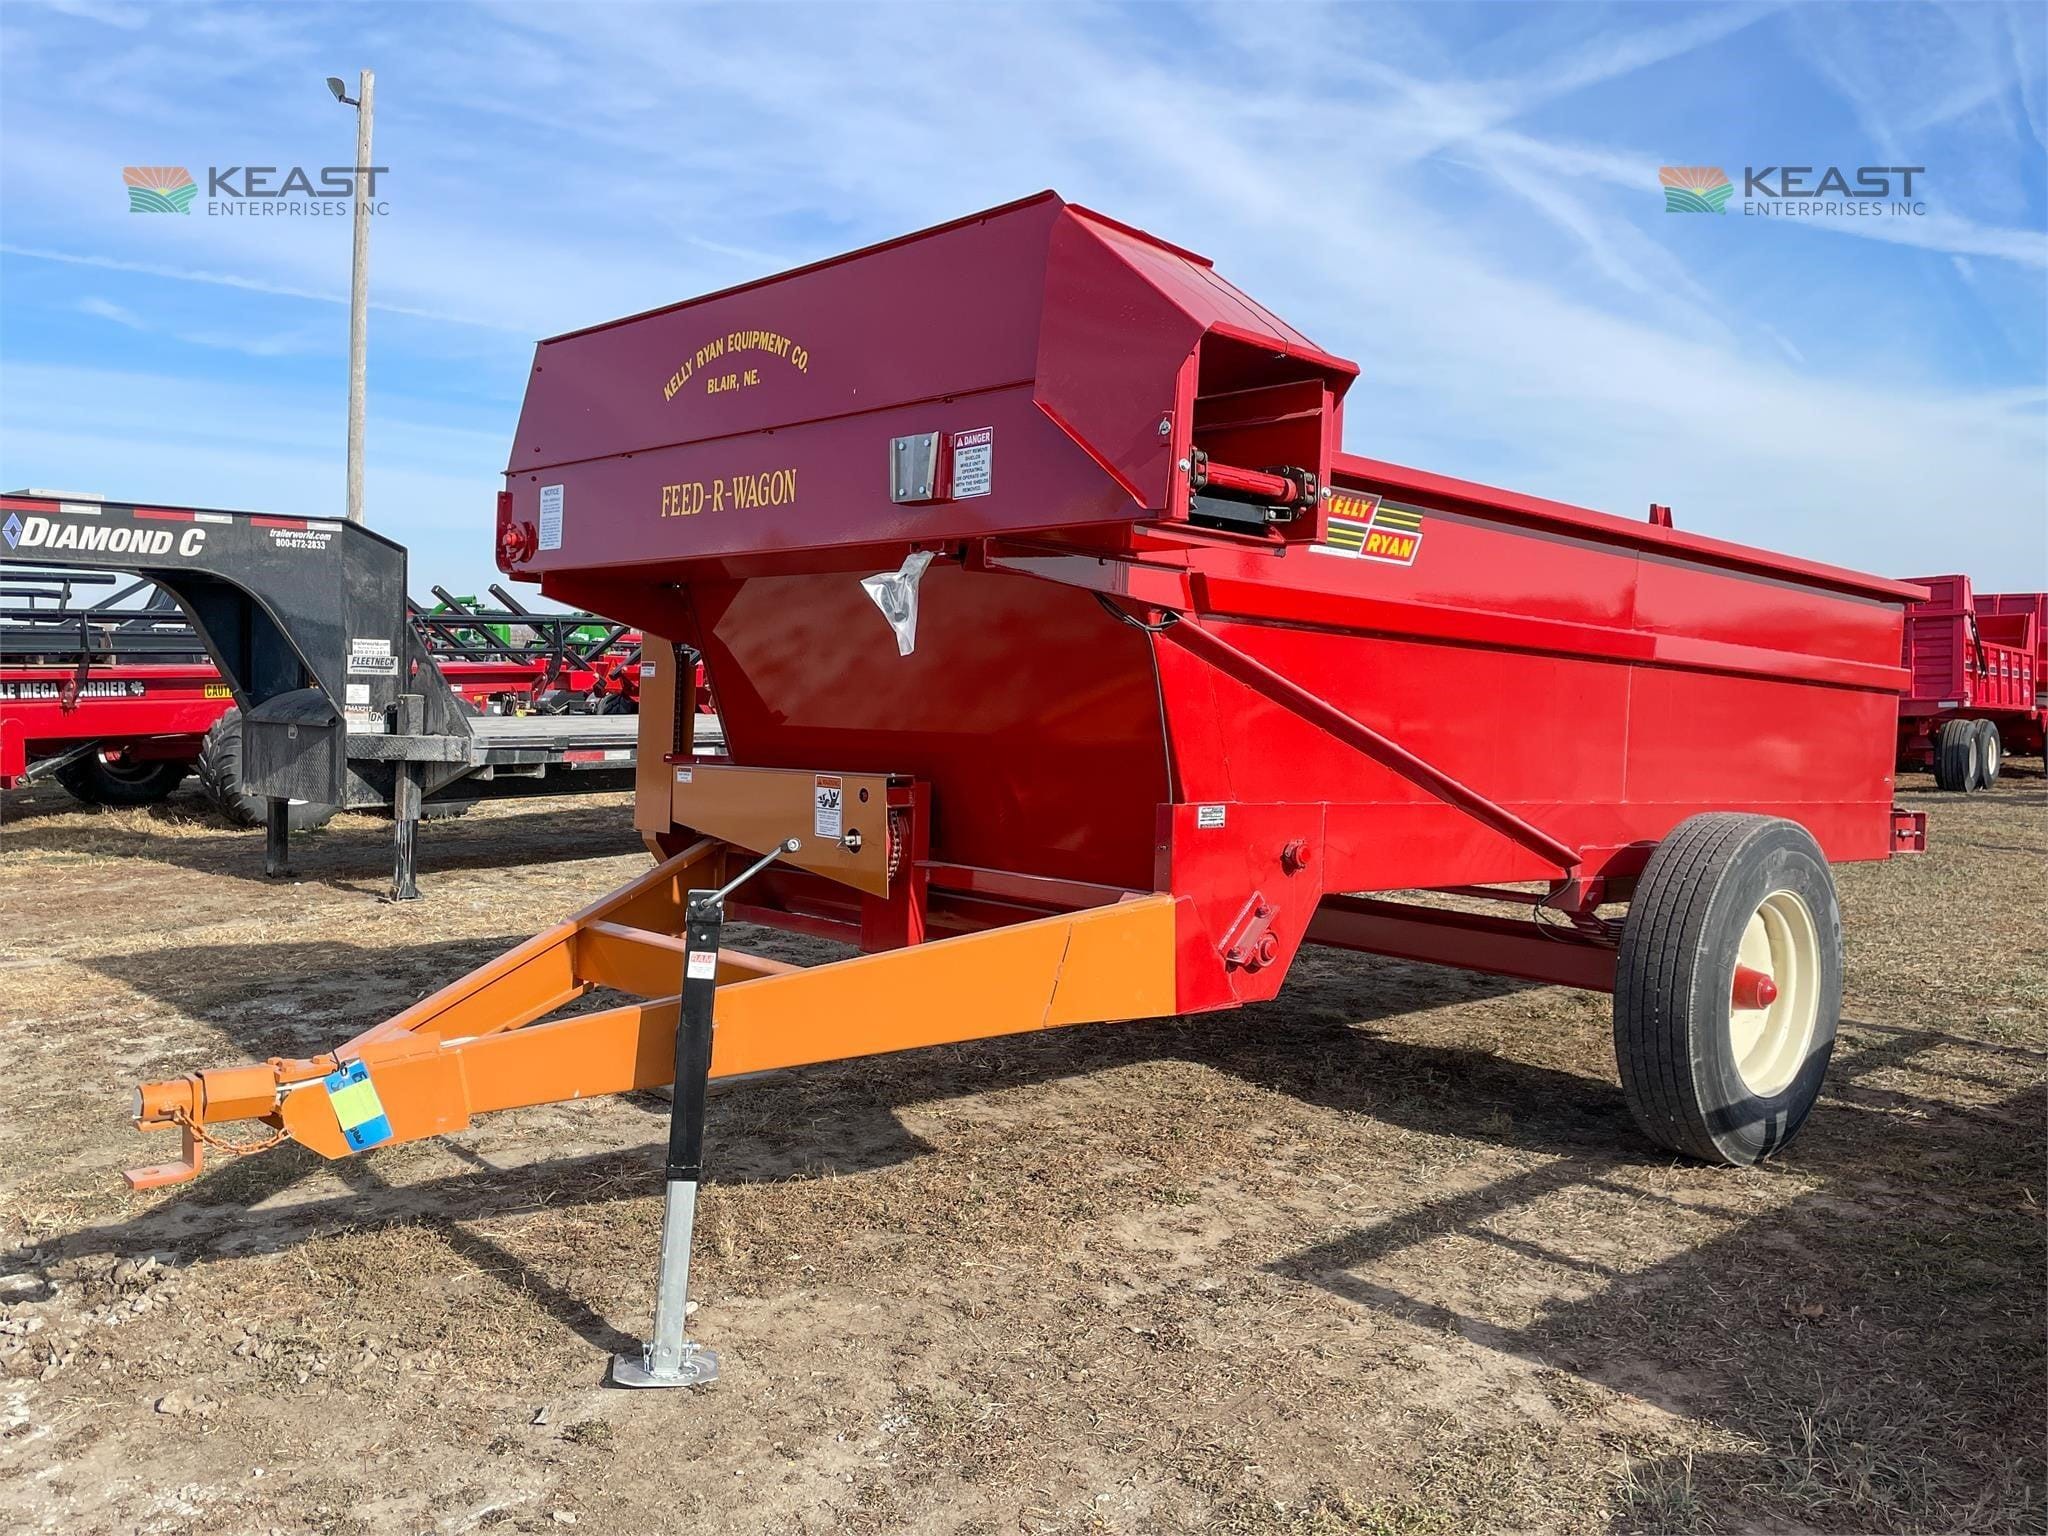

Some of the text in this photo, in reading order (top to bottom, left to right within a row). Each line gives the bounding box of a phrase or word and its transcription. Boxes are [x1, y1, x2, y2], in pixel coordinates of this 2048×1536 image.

[663, 330, 808, 401] KELLY RYAN EQUIPMENT CO.
[707, 368, 761, 394] BLAIR, NE.
[964, 432, 990, 446] DANGER
[660, 468, 797, 518] FEED-R-WAGON
[18, 516, 206, 557] DIAMOND C
[269, 529, 332, 541] trailerworld.com
[275, 538, 326, 550] 800-872-2833
[1366, 533, 1415, 558] RYAN
[352, 656, 395, 666] FLEETNECK
[20, 682, 59, 698] MEGA
[78, 681, 127, 697] ARRIER
